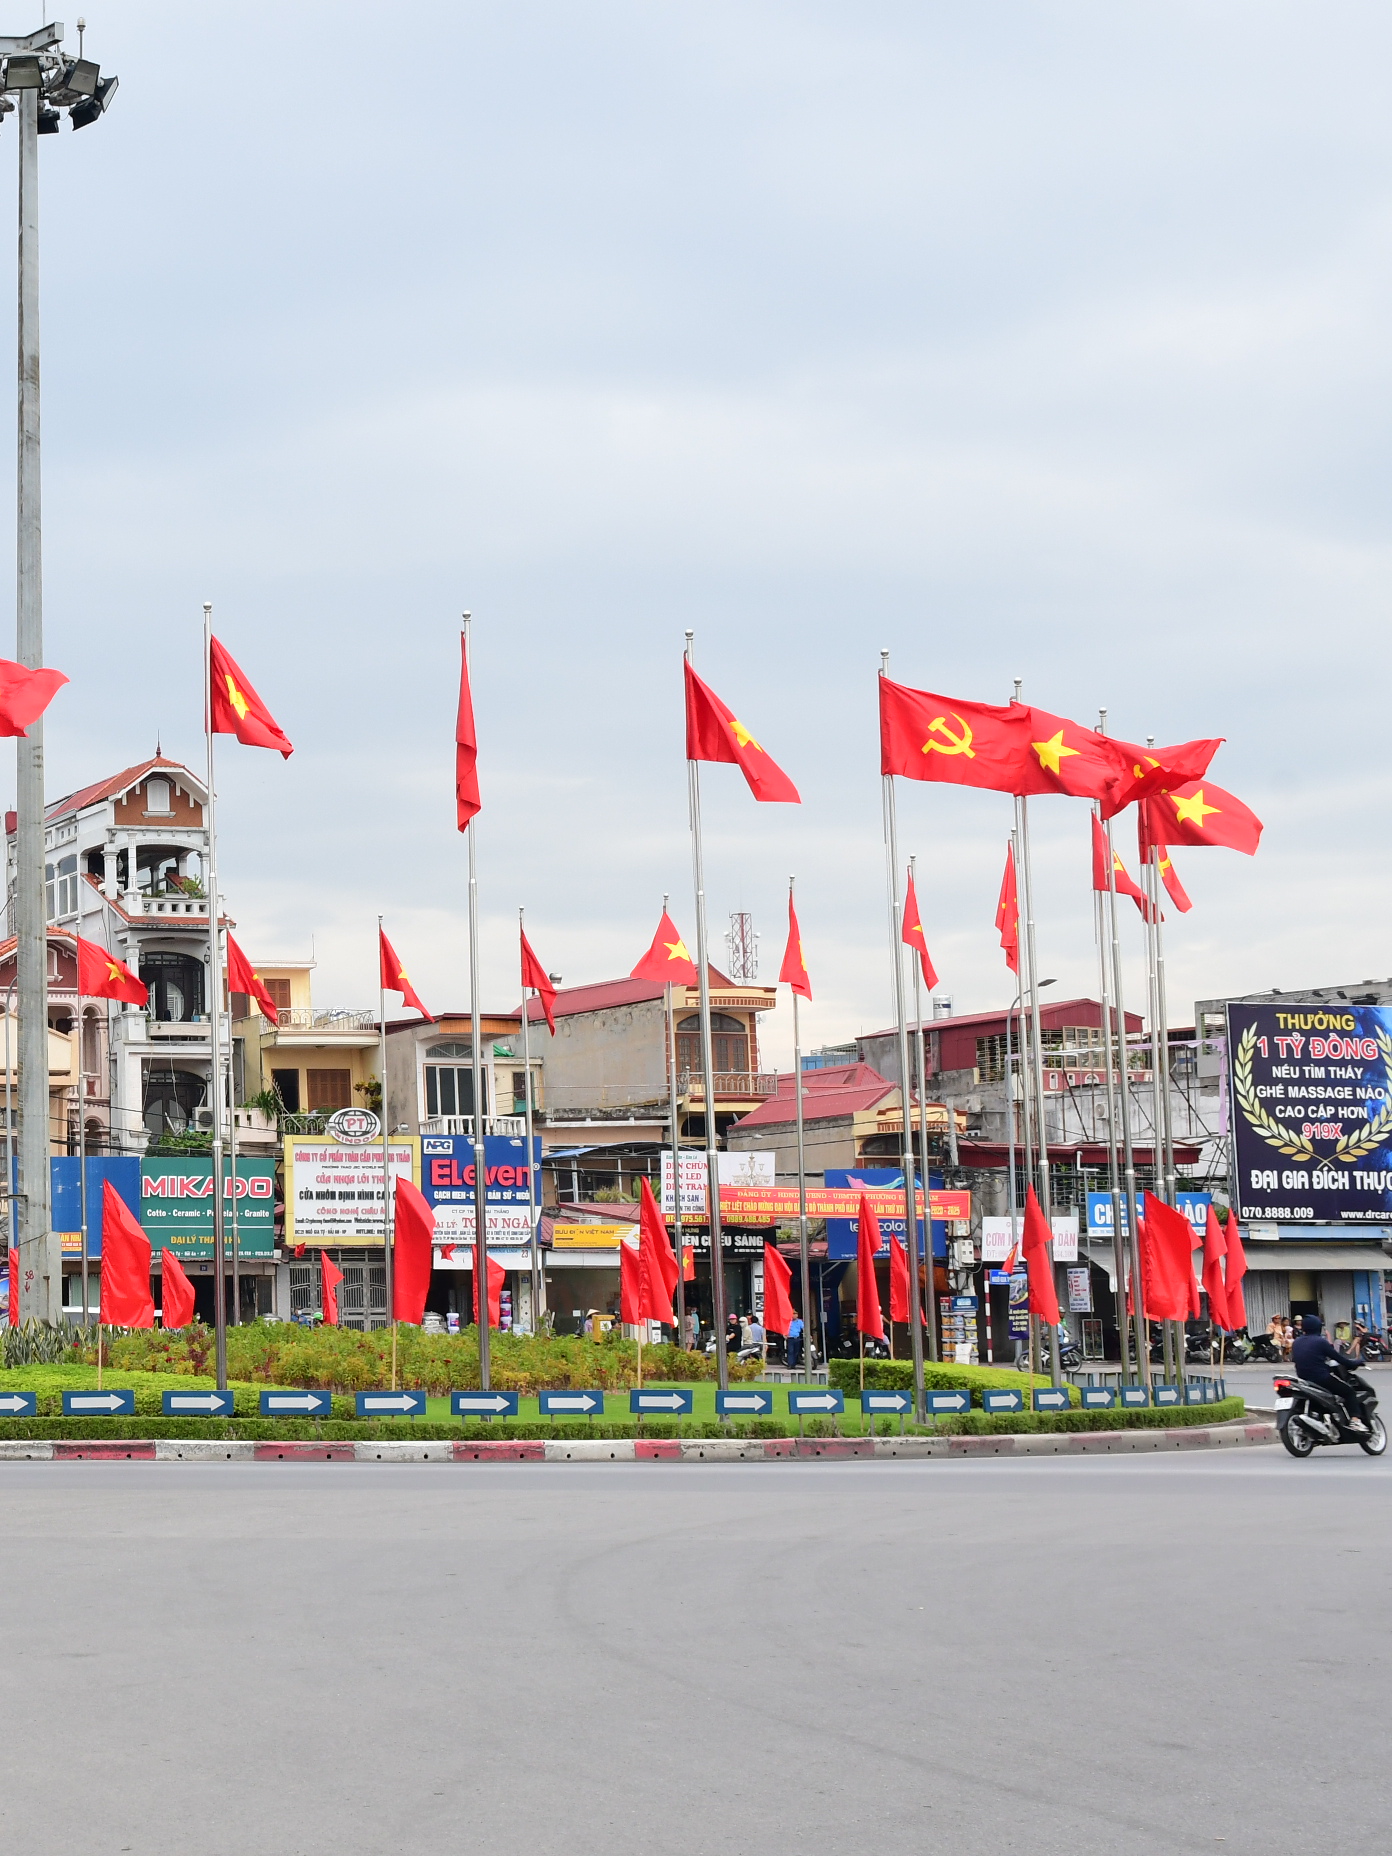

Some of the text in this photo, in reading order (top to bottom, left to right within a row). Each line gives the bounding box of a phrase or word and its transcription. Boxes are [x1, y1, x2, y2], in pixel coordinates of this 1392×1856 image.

[1275, 1011, 1355, 1030] THƯỞNG
[1257, 1032, 1378, 1059] 1 TỶ ĐỒNG
[1302, 1064, 1325, 1079] TÌM
[1288, 1086, 1353, 1099] MASSAGE
[1356, 1085, 1385, 1100] NÀO
[1275, 1105, 1304, 1118] CAO
[1338, 1106, 1368, 1119] HƠN
[345, 1118, 365, 1130] PT
[1302, 1122, 1343, 1139] 919X
[426, 1141, 451, 1150] NPG
[1251, 1169, 1278, 1193] ĐẠI
[1281, 1170, 1309, 1190] GIA
[1312, 1166, 1350, 1190] ĐÍCH
[147, 1208, 167, 1217] Cotto
[172, 1208, 201, 1217] Ceramic
[244, 1208, 269, 1217] Granite
[1242, 1206, 1314, 1219] 070.8888.009
[734, 1233, 763, 1247] SÁNG
